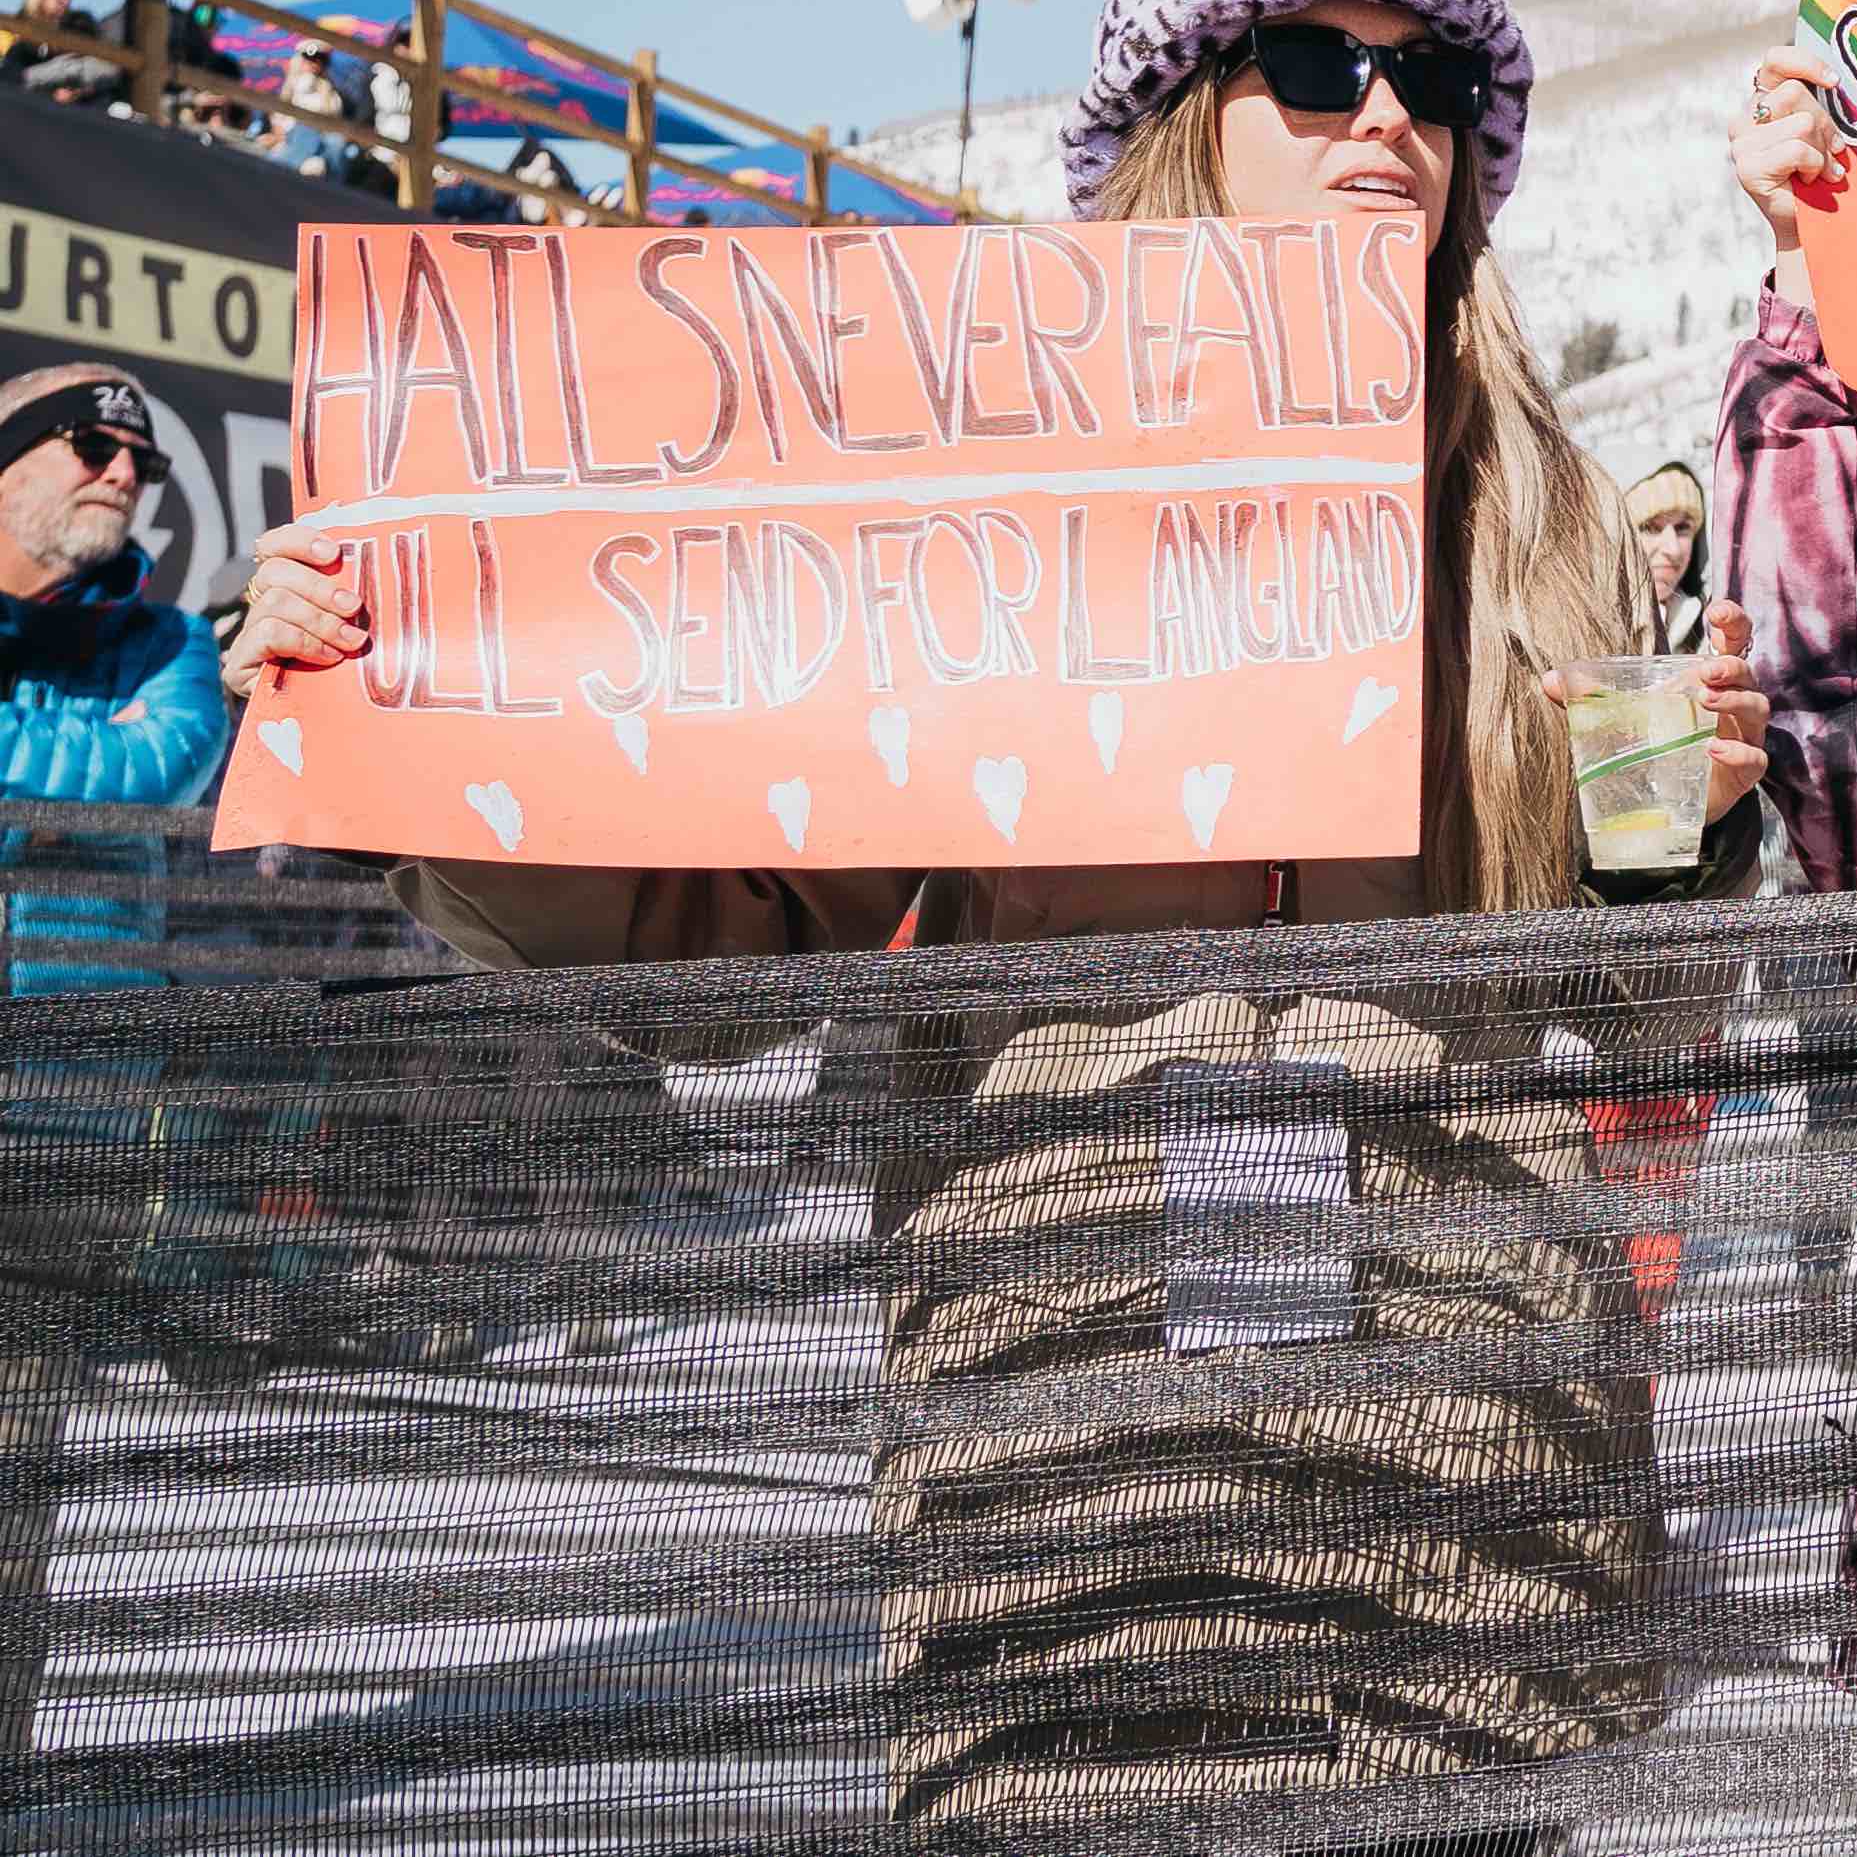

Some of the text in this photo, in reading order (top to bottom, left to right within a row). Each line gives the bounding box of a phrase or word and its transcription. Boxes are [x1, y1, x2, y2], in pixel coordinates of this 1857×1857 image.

[0, 222, 297, 368] URTO
[728, 223, 1109, 465] NEVER
[1124, 216, 1424, 431] FAILS
[270, 489, 1423, 719] ULL SEND FOR LANGLAND
